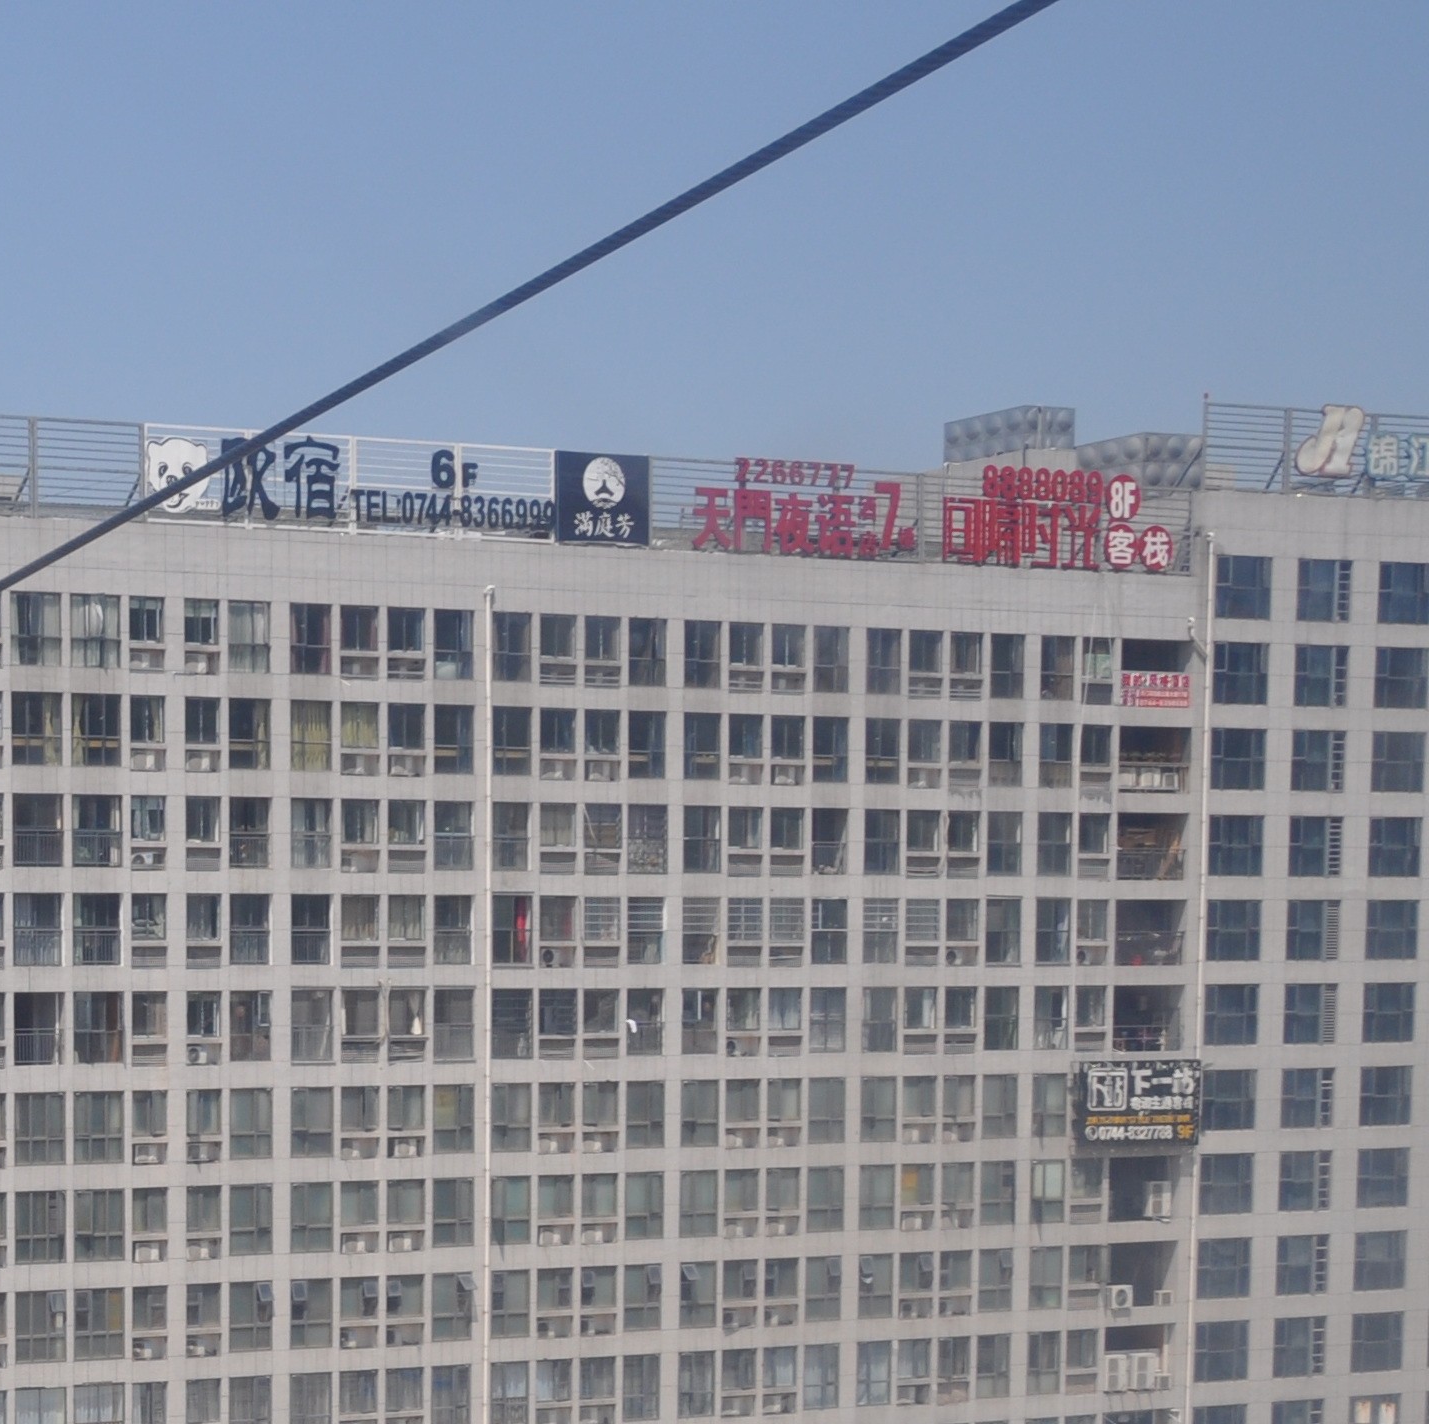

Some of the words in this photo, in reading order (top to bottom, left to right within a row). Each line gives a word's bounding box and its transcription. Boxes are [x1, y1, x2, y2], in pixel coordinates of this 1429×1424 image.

[431, 449, 479, 490] 6F
[734, 457, 855, 488] 2266777
[351, 488, 557, 541] TEL:0744-8366999
[1110, 481, 1136, 519] 8F
[1106, 529, 1171, 567] 客栈
